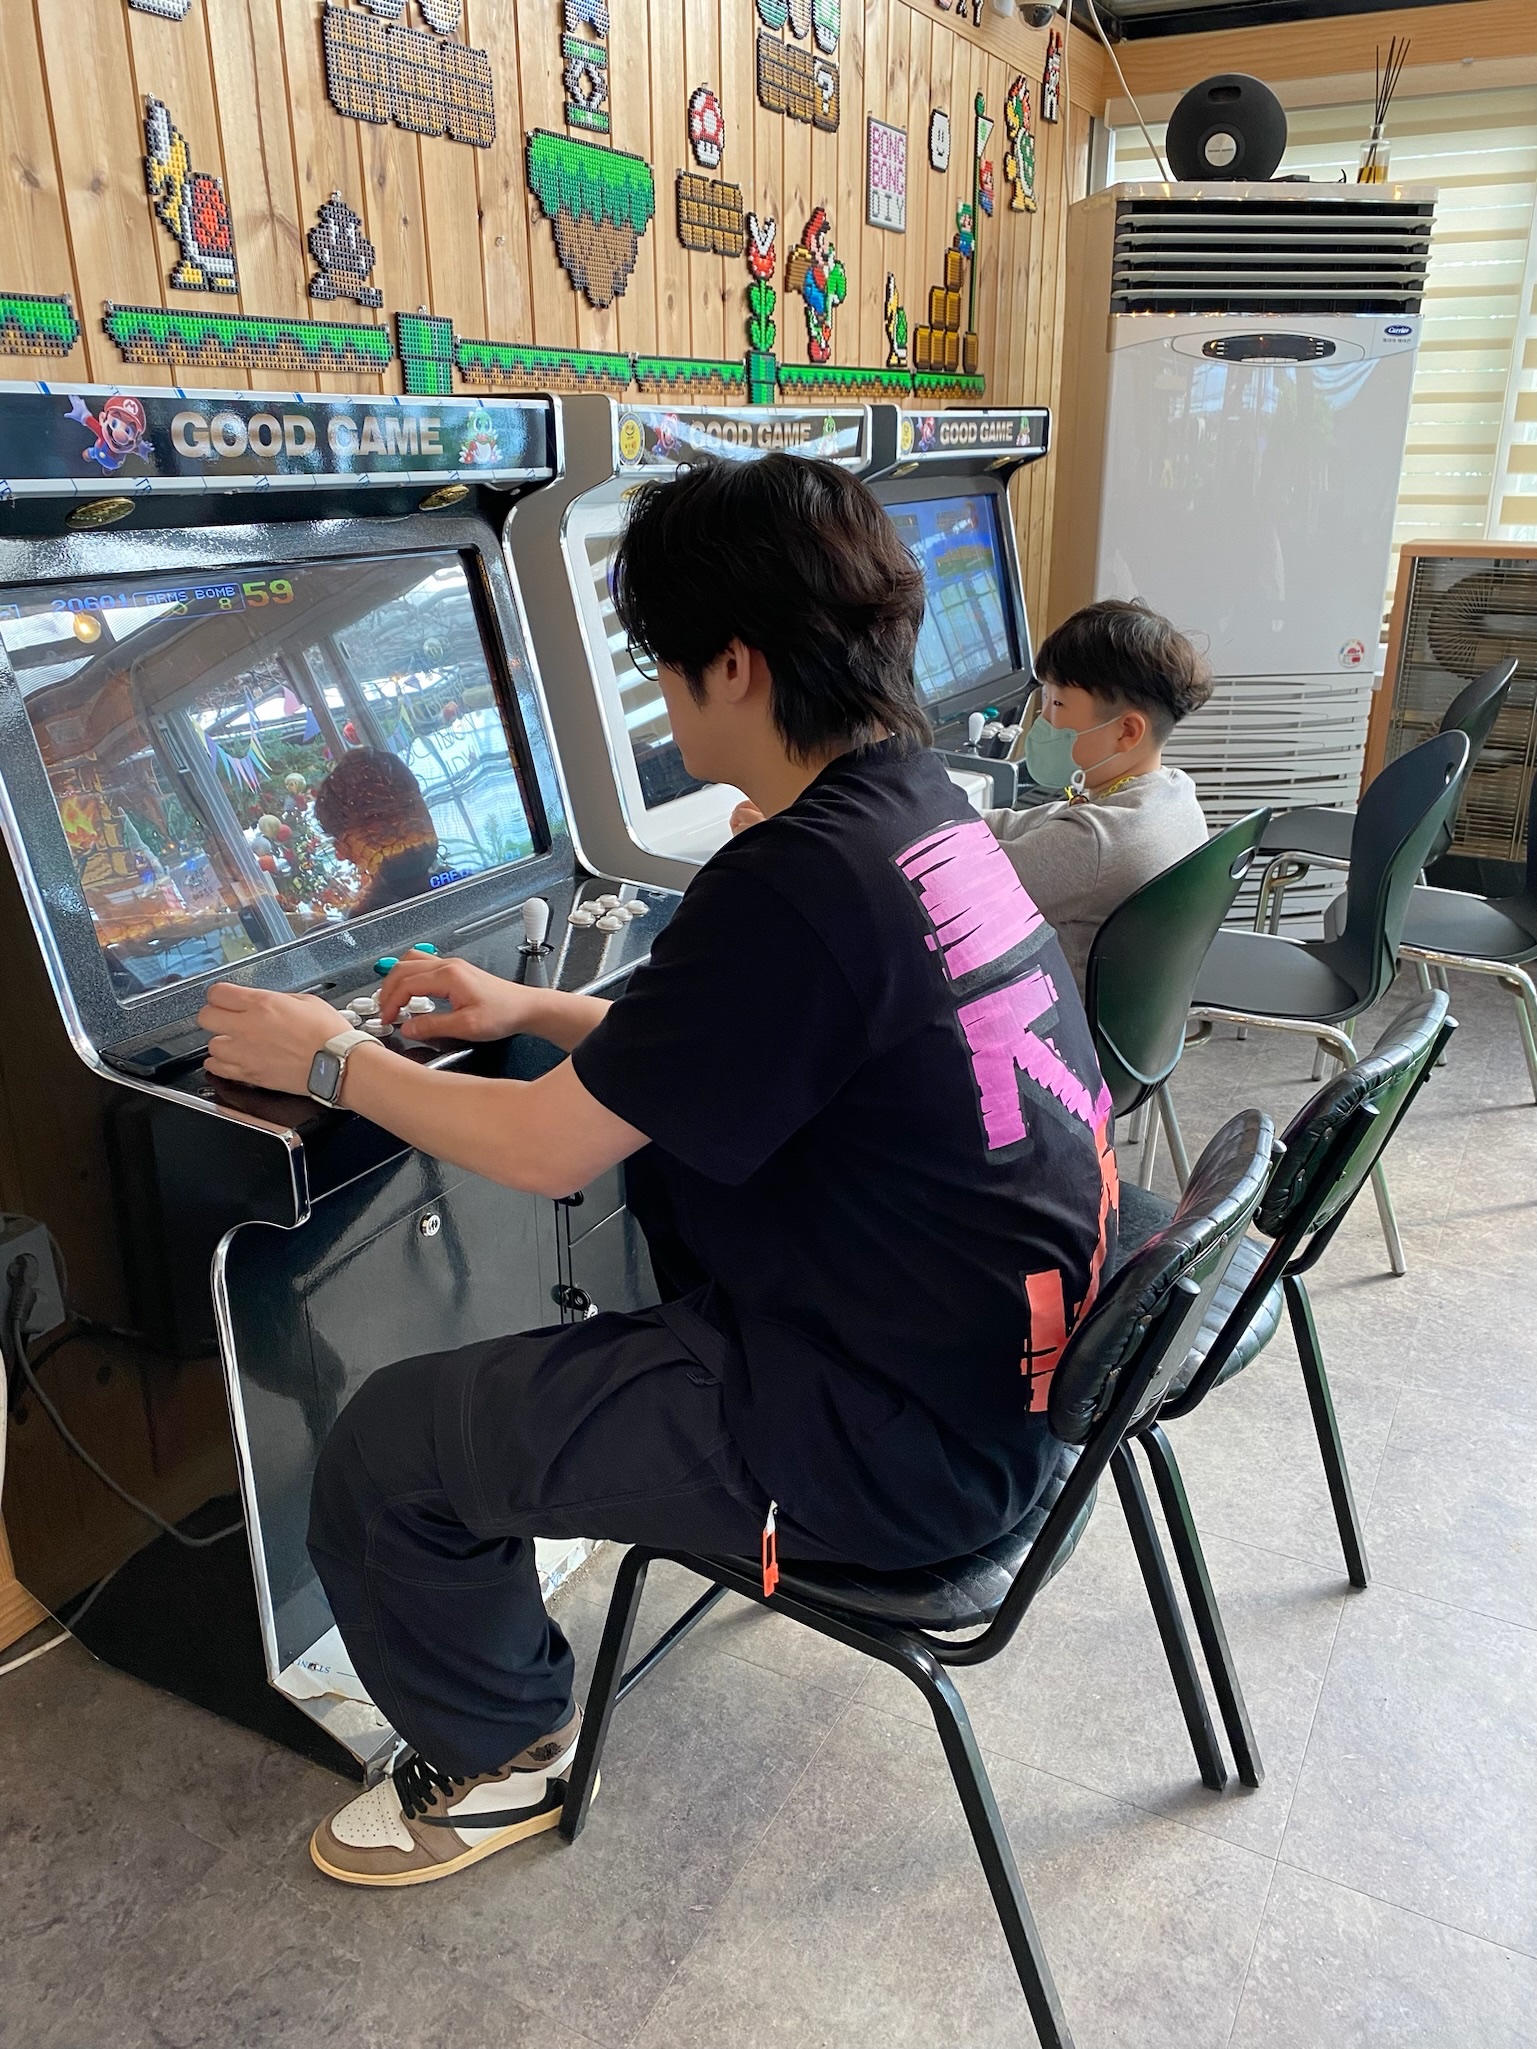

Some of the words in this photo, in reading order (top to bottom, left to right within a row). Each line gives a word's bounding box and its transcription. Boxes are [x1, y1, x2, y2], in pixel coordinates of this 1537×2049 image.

[872, 125, 905, 165] BONG
[872, 158, 904, 195] BONG
[872, 189, 904, 224] DIY
[170, 411, 316, 458] GOOD
[327, 415, 444, 456] GAME
[689, 420, 753, 450] GOOD
[757, 422, 811, 449] GAME
[940, 421, 978, 445] GOOD
[980, 421, 1014, 443] GAME
[146, 590, 188, 605] ARMS
[196, 586, 236, 600] BOMB
[218, 597, 231, 610] 8
[242, 579, 294, 607] 59
